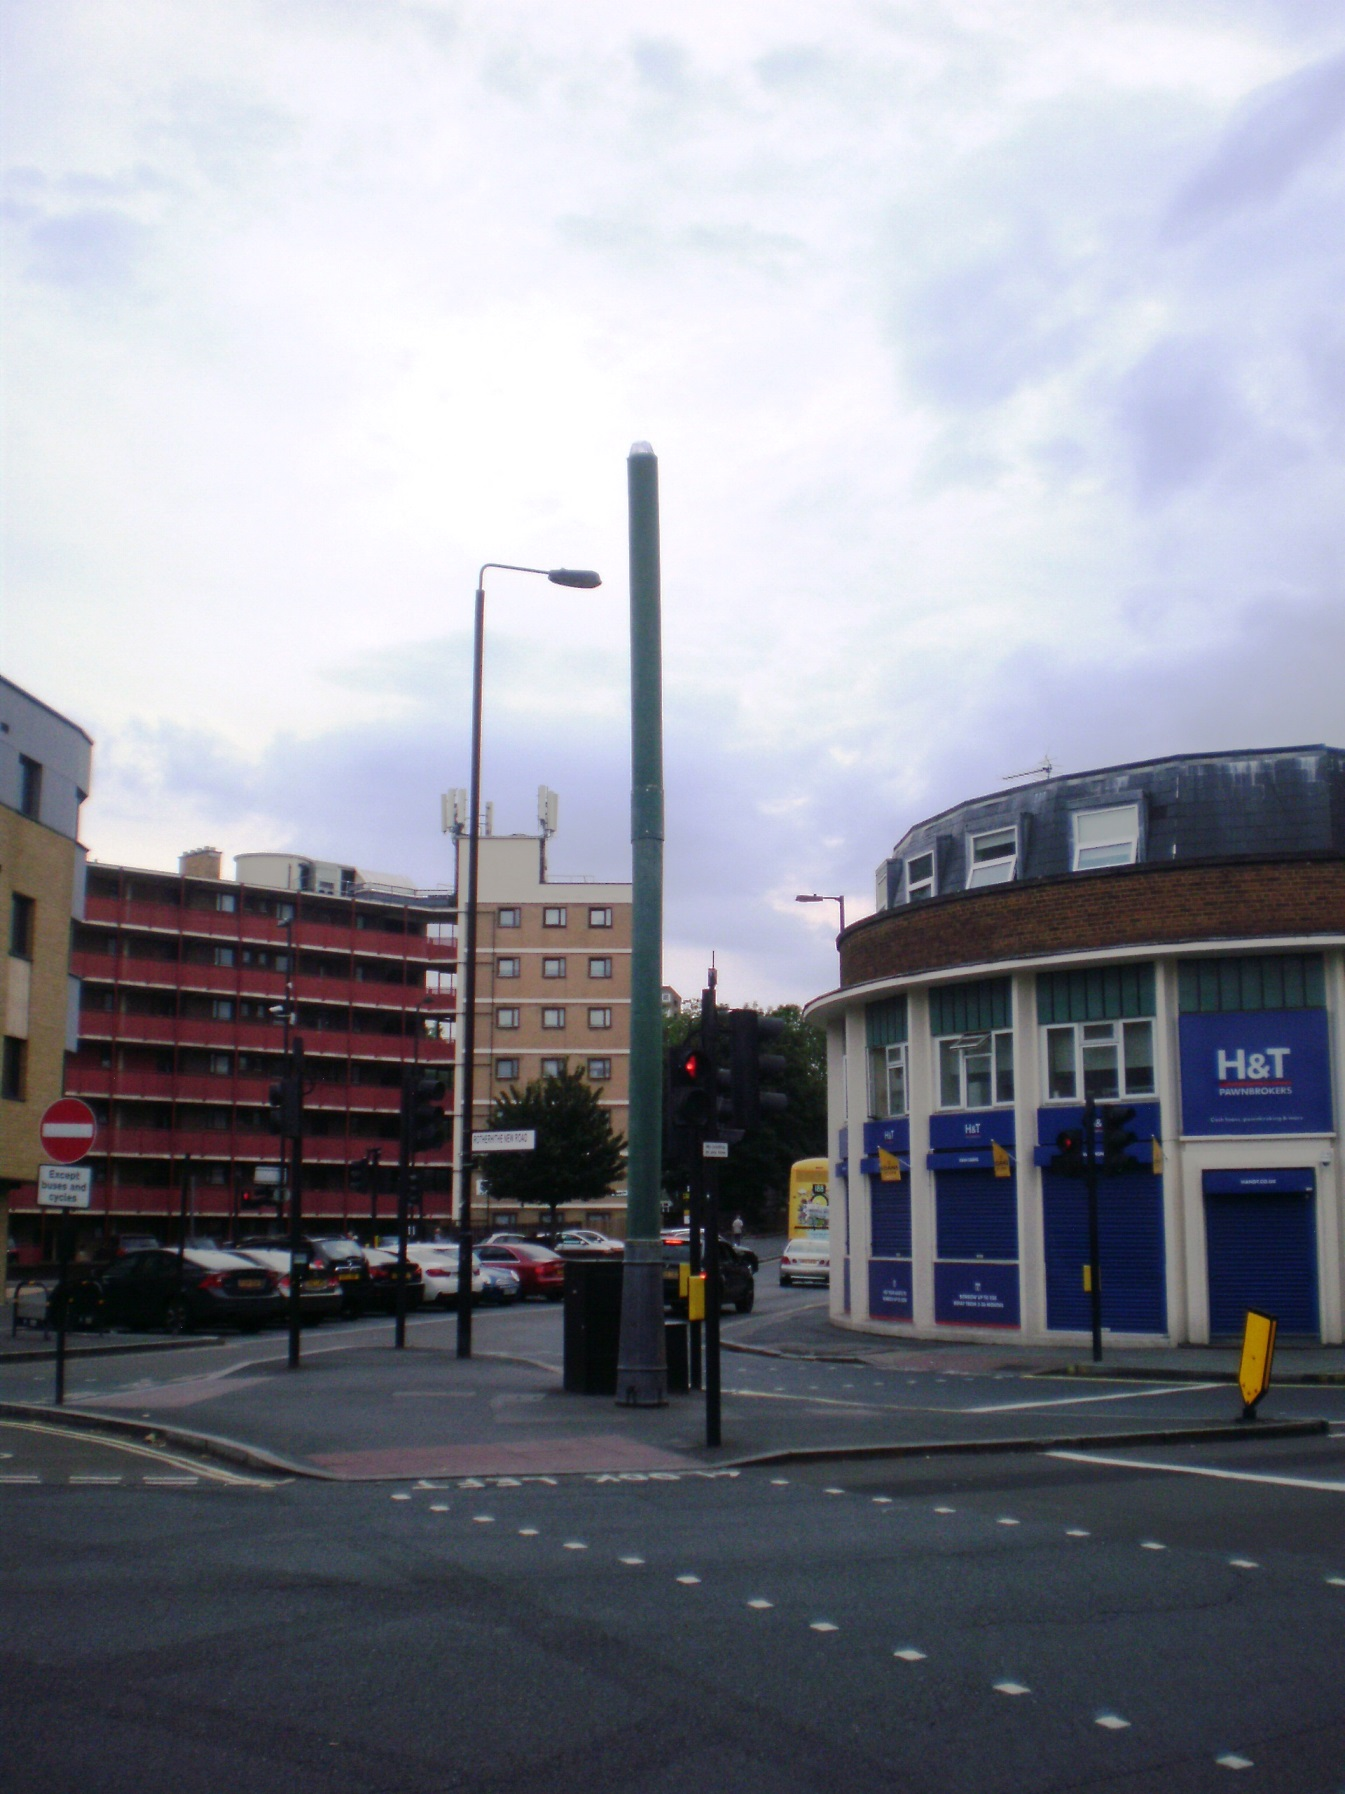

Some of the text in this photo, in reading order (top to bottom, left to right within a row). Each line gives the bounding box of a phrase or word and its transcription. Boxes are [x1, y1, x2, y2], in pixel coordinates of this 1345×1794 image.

[1217, 1048, 1291, 1080] H&T
[1219, 1086, 1292, 1096] PAWNBROKERS
[965, 1123, 981, 1134] H&T
[504, 1133, 514, 1143] NEW
[515, 1133, 527, 1143] ROAD
[884, 1130, 894, 1139] H&T
[49, 1170, 80, 1180] Except
[42, 1181, 86, 1192] buses and
[49, 1193, 77, 1203] cycles
